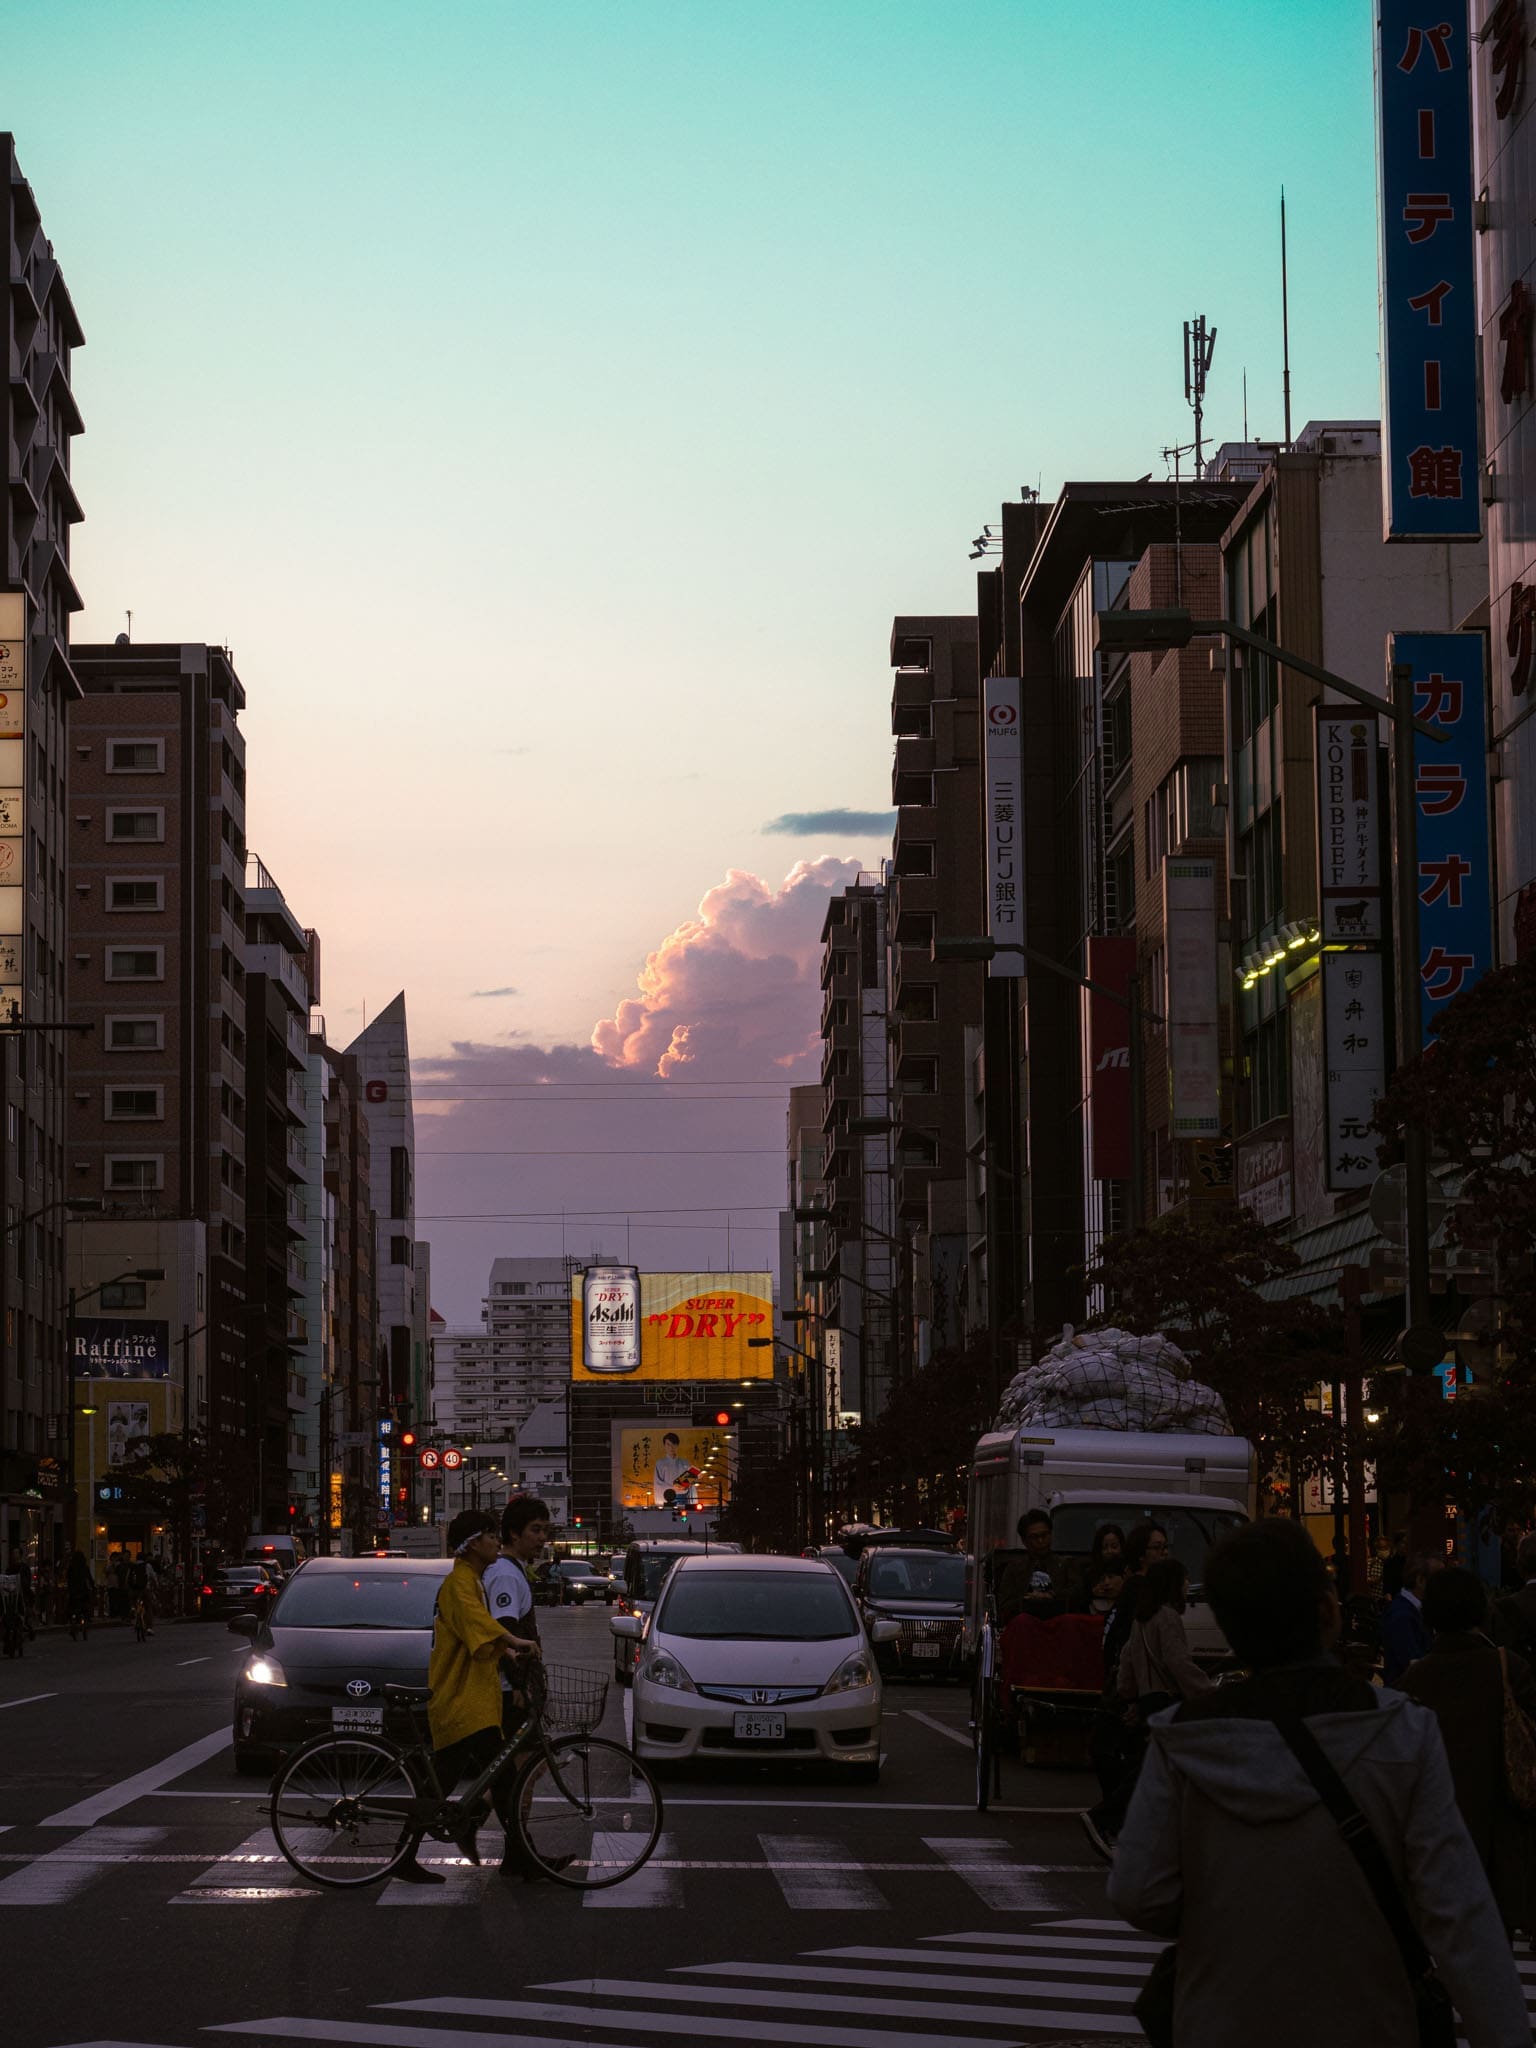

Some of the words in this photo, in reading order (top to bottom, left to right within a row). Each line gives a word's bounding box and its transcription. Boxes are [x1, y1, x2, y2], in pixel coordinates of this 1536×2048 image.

[1396, 22, 1464, 499] パーティー館
[988, 728, 1018, 737] MUFG
[994, 782, 1017, 923] 三菱UFJ銀行
[1414, 672, 1475, 1060] カラオケ
[1342, 999, 1369, 1054] 舟和
[589, 1302, 634, 1322] Asahi
[686, 1298, 736, 1310] SUPER
[74, 1336, 158, 1359] Raffine
[446, 1454, 458, 1464] 40
[746, 1723, 783, 1737] 85-19
